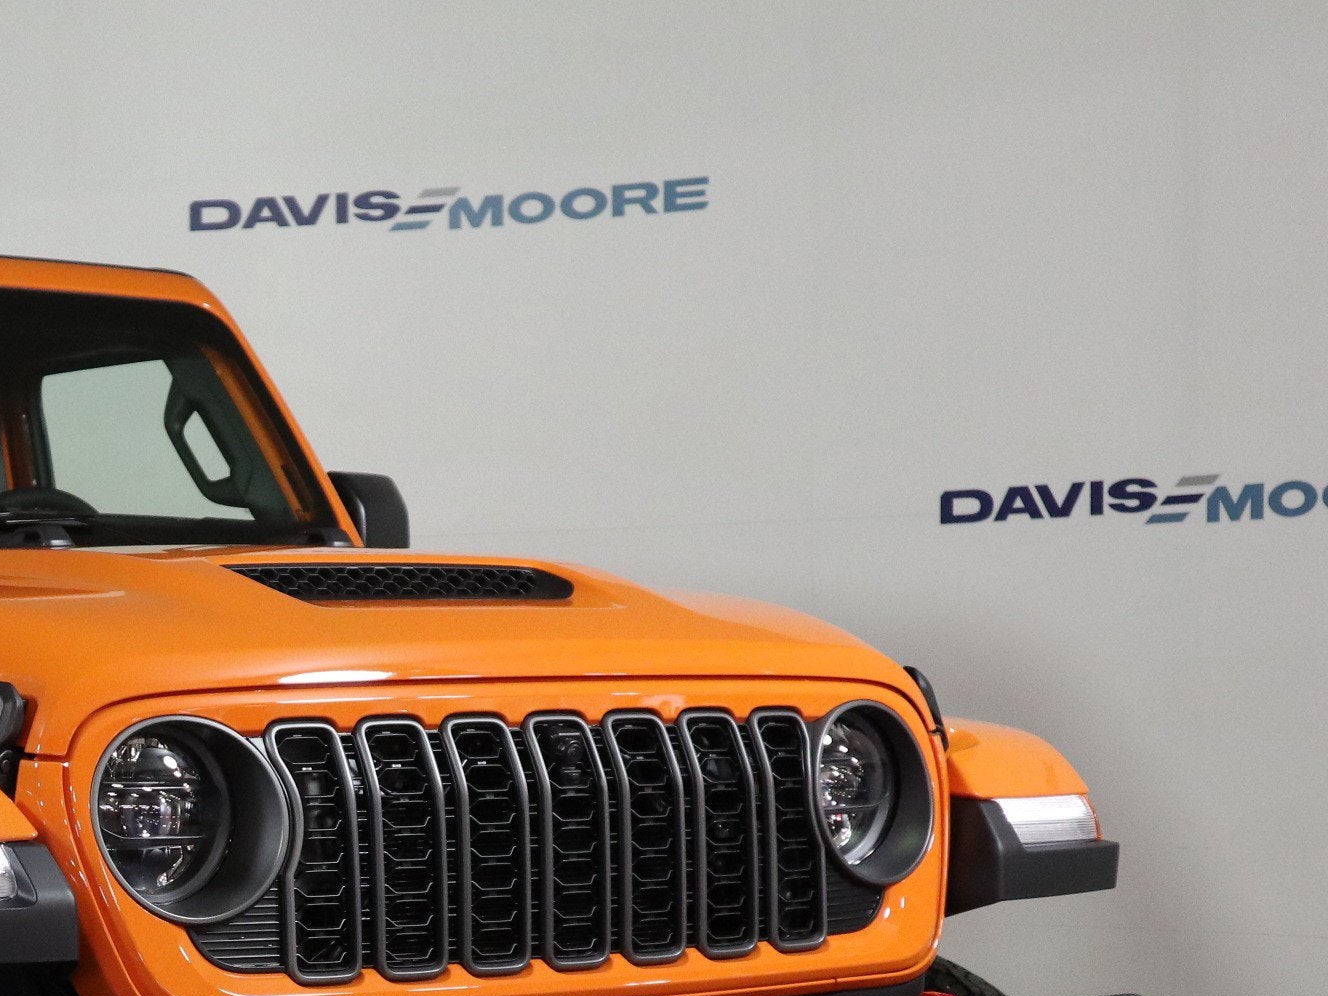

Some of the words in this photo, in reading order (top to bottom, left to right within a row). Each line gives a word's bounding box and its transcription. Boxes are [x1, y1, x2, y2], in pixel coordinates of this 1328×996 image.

[188, 190, 401, 232] DAVIS
[448, 176, 710, 230] MOORE
[939, 477, 1158, 525] DAVIS
[1206, 480, 1328, 523] MO
